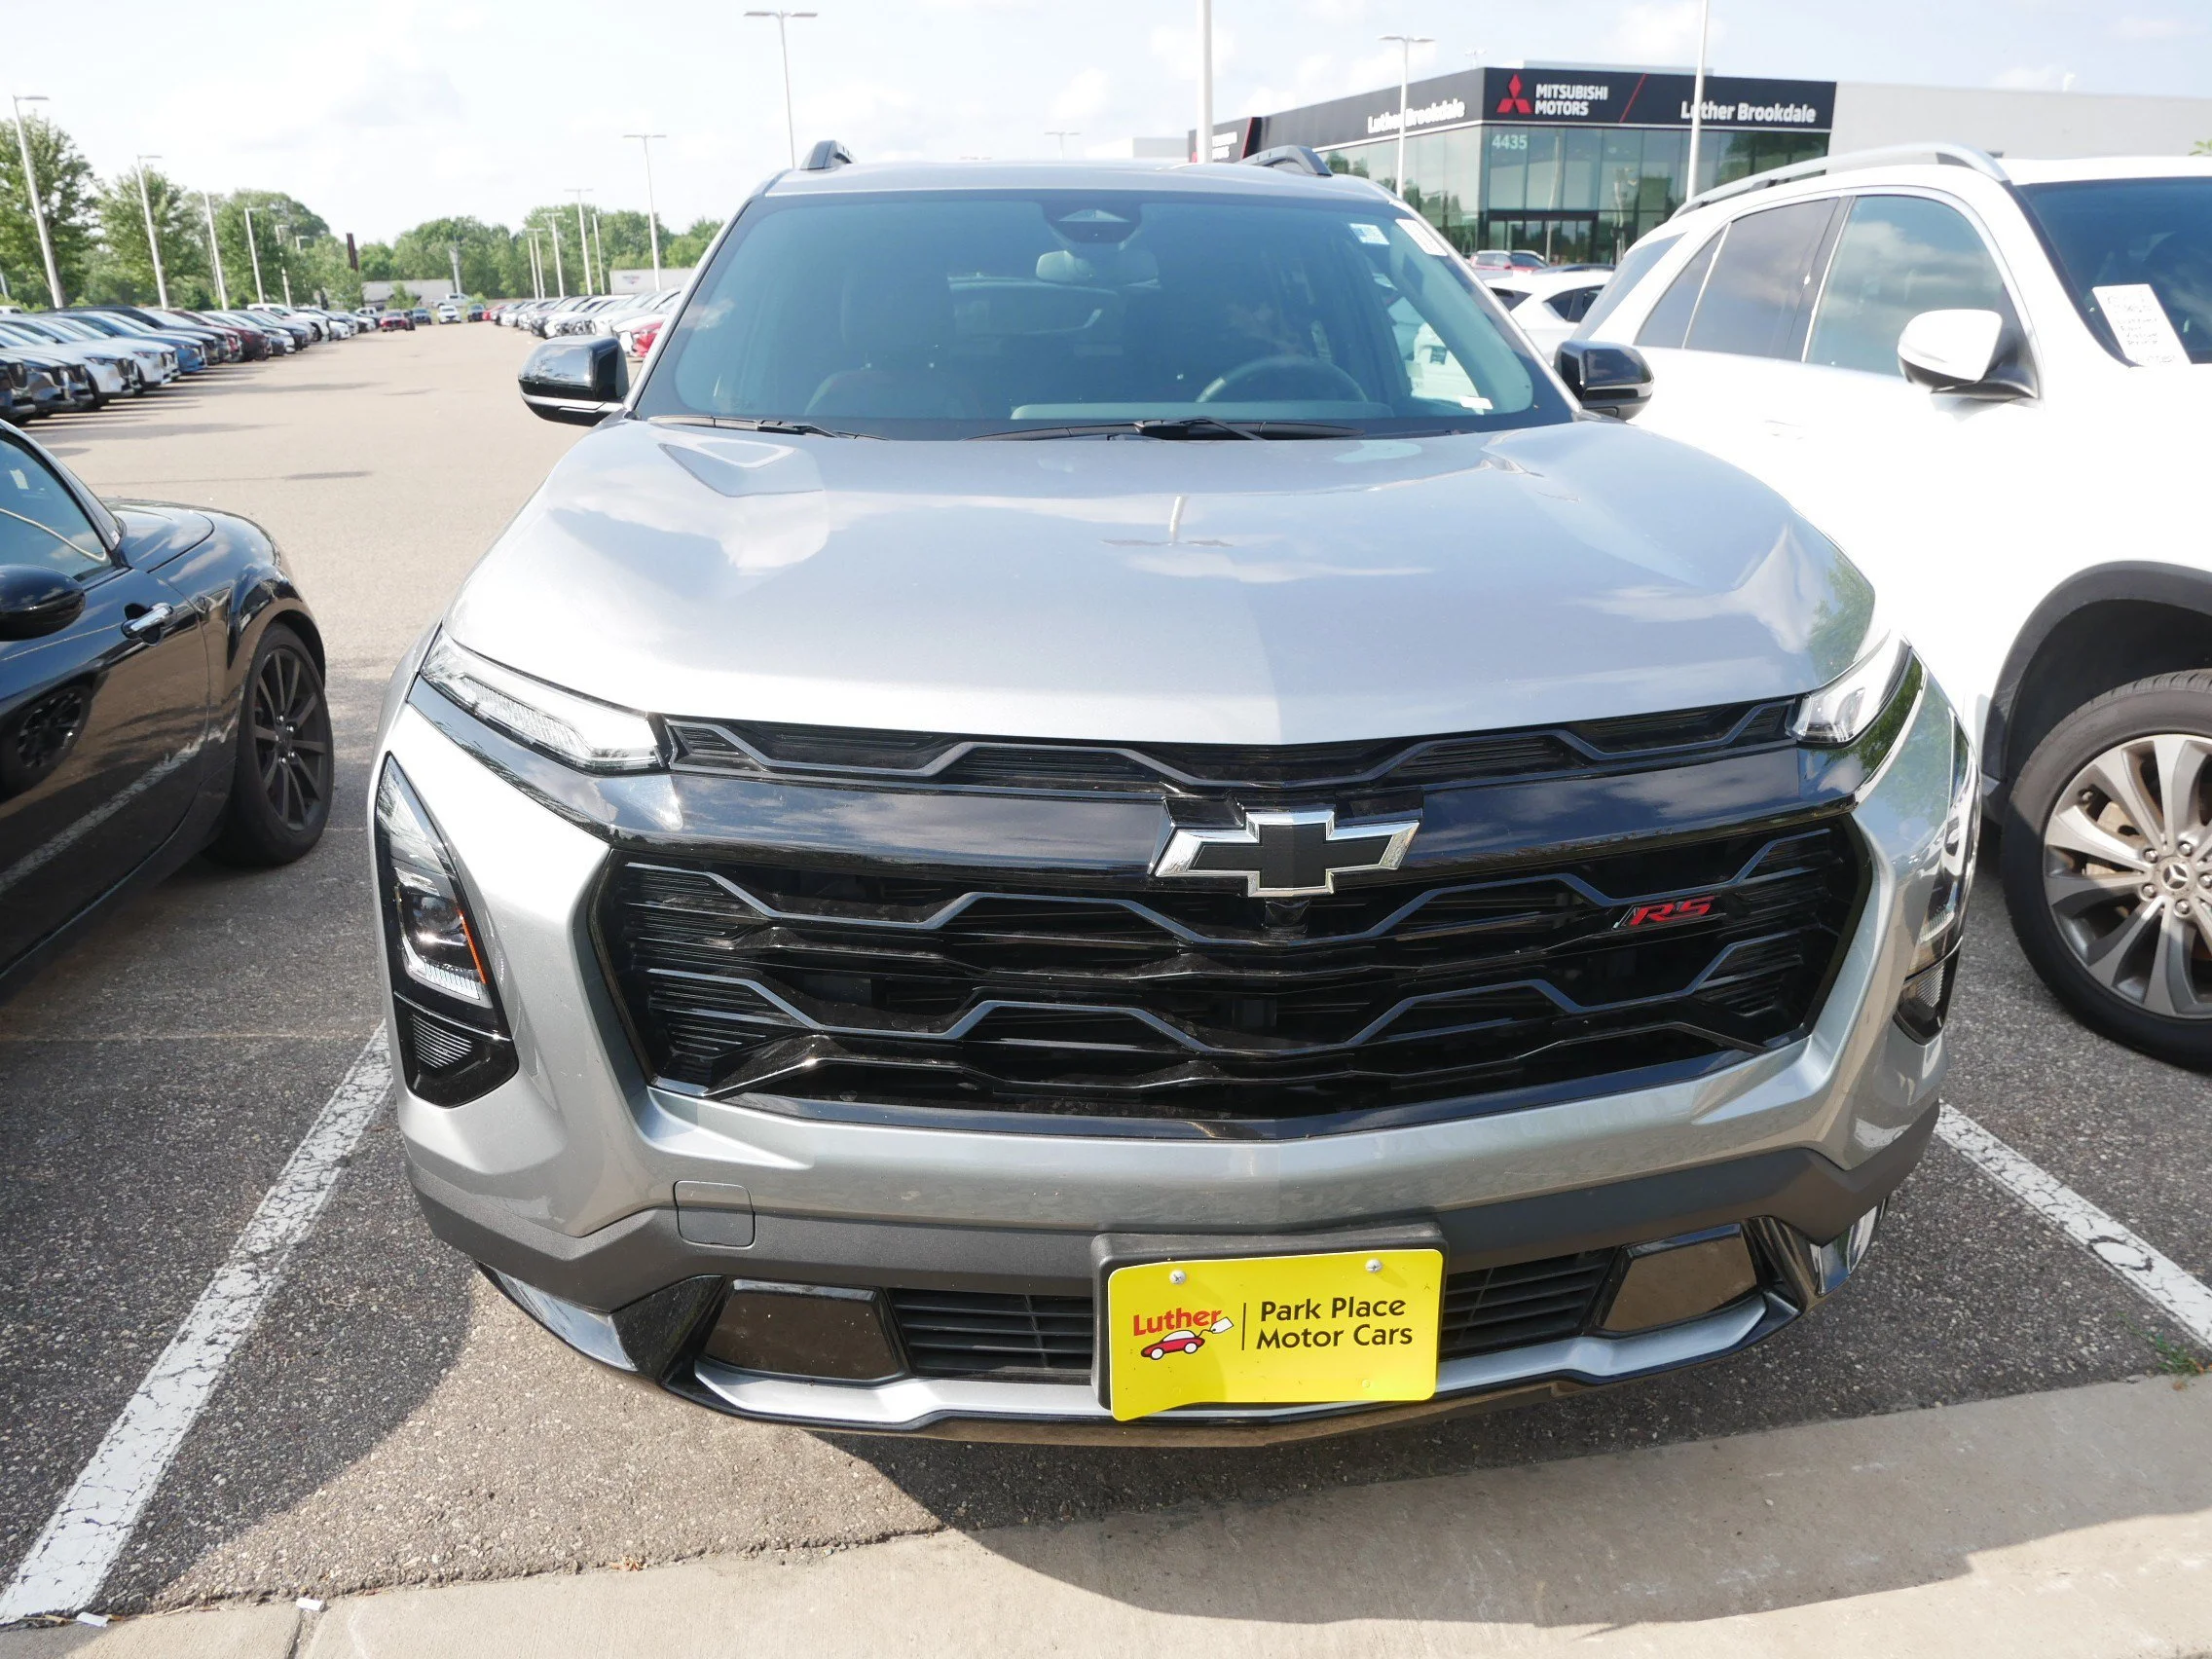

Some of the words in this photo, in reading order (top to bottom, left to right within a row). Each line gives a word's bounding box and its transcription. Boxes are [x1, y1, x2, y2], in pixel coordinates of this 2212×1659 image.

[1535, 84, 1608, 100] MITSUBISHI
[1534, 100, 1589, 116] MOTORS
[1680, 100, 1736, 120] Lther
[1737, 102, 1817, 123] Brookdale
[1492, 134, 1528, 150] 4435
[1630, 895, 1715, 926] RS
[1260, 1298, 1322, 1322] Park
[1331, 1296, 1407, 1320] Place
[1132, 1307, 1223, 1337] Luther
[1256, 1327, 1345, 1350] Motor
[1353, 1323, 1414, 1347] Cars
